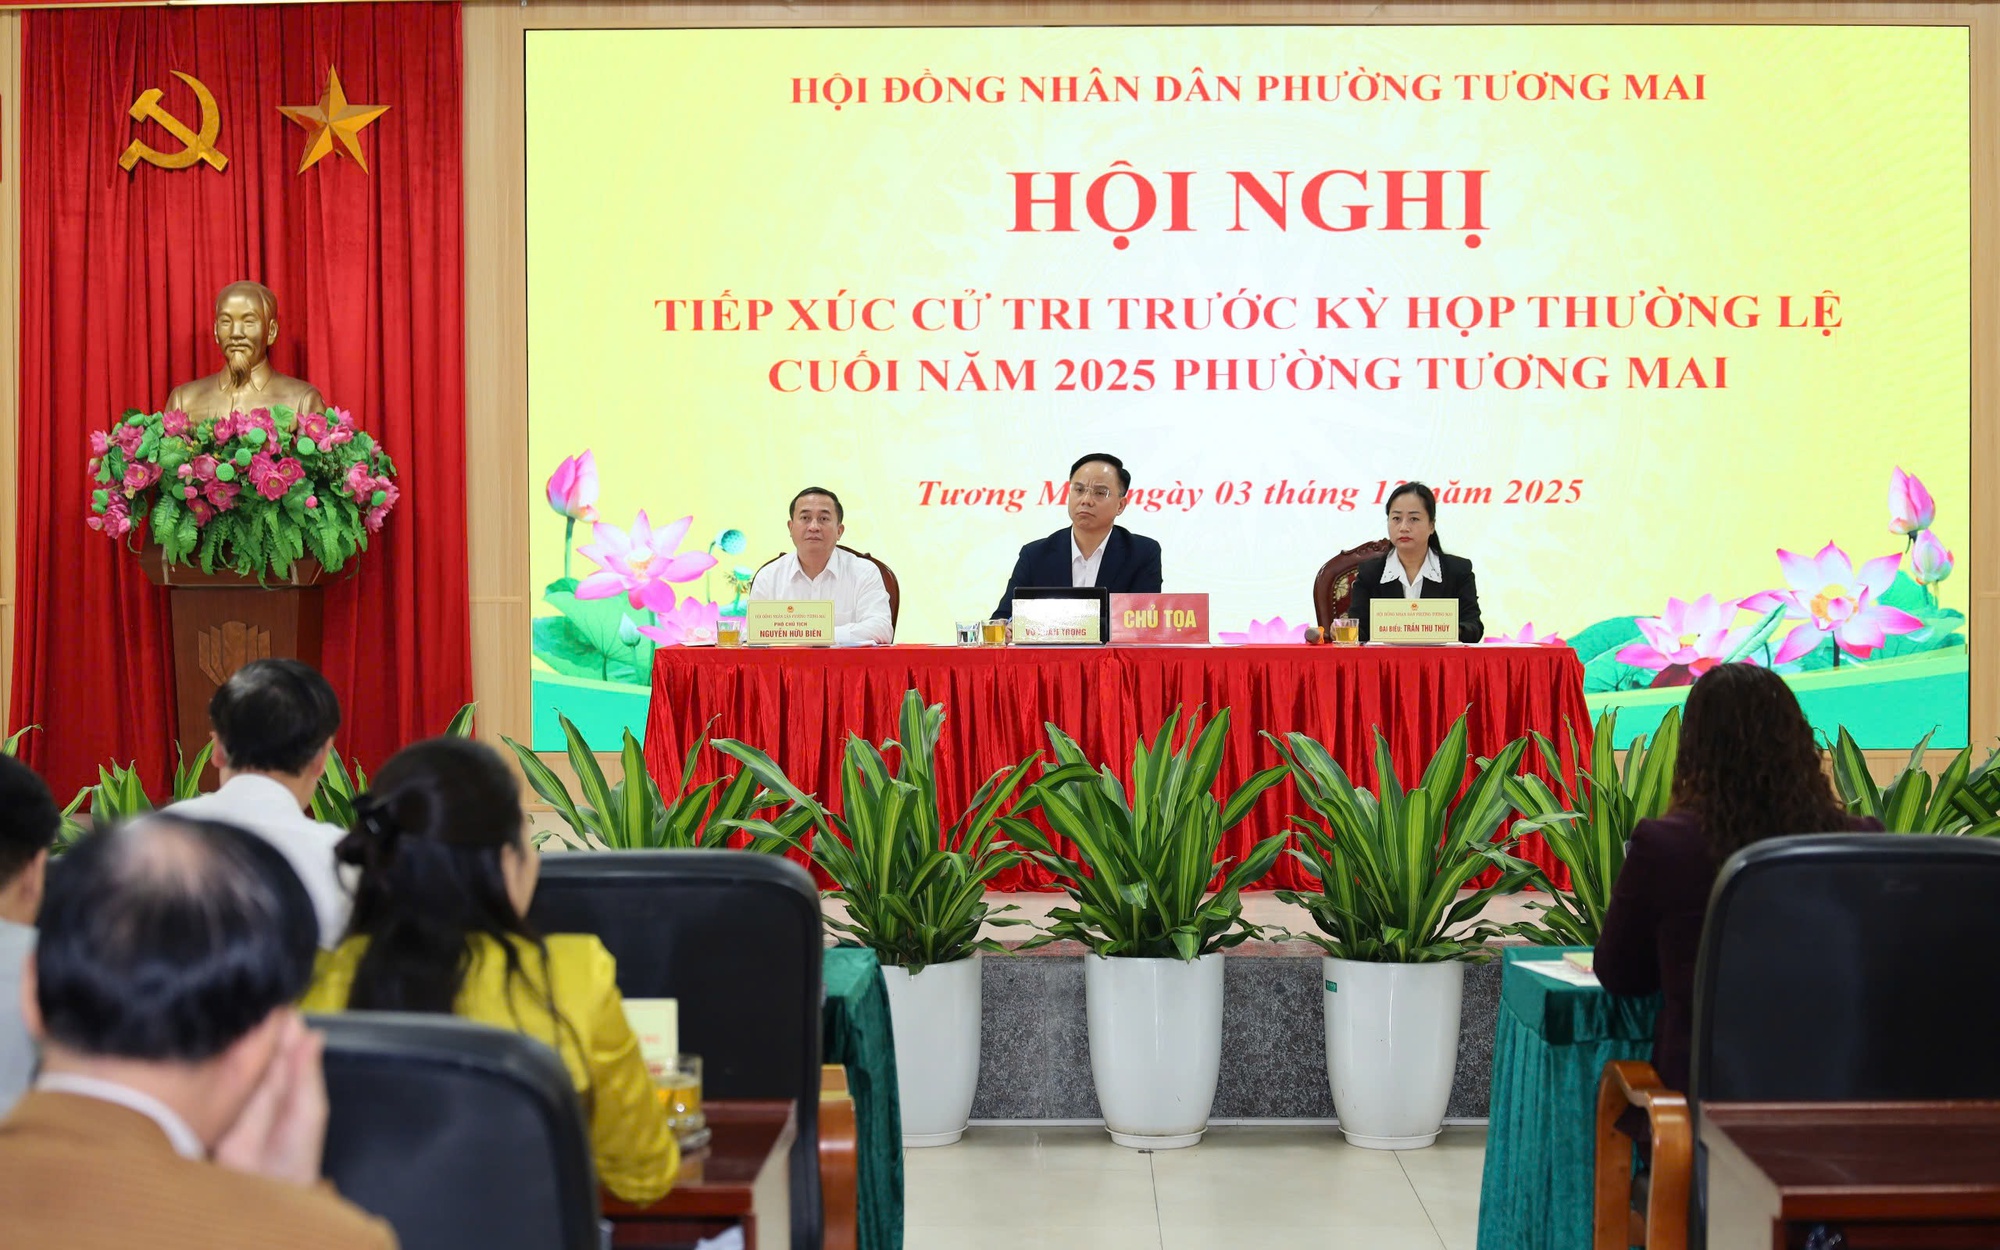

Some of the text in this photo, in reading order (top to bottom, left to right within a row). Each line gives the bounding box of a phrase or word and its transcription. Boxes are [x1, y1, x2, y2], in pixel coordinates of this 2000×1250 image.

[790, 66, 1708, 112] HỘI ĐỒNG NHÂN DÂN PHƯỜNG TƯƠNG MAI
[1006, 159, 1491, 251] HỘI NGHỊ
[654, 285, 1844, 338] TIẾP XÚC CỬ TRI TRƯỚC KỲ HỌP THƯỜNG LỆ
[767, 348, 1730, 394] CUỐI NĂM 2025 PHƯỜNG TƯƠNG MAI
[918, 480, 1028, 513] Tương
[1214, 480, 1254, 506] 03
[1264, 479, 1360, 512] tháng
[1503, 479, 1585, 505] 2025
[1123, 603, 1197, 632] CHỦ TỌA
